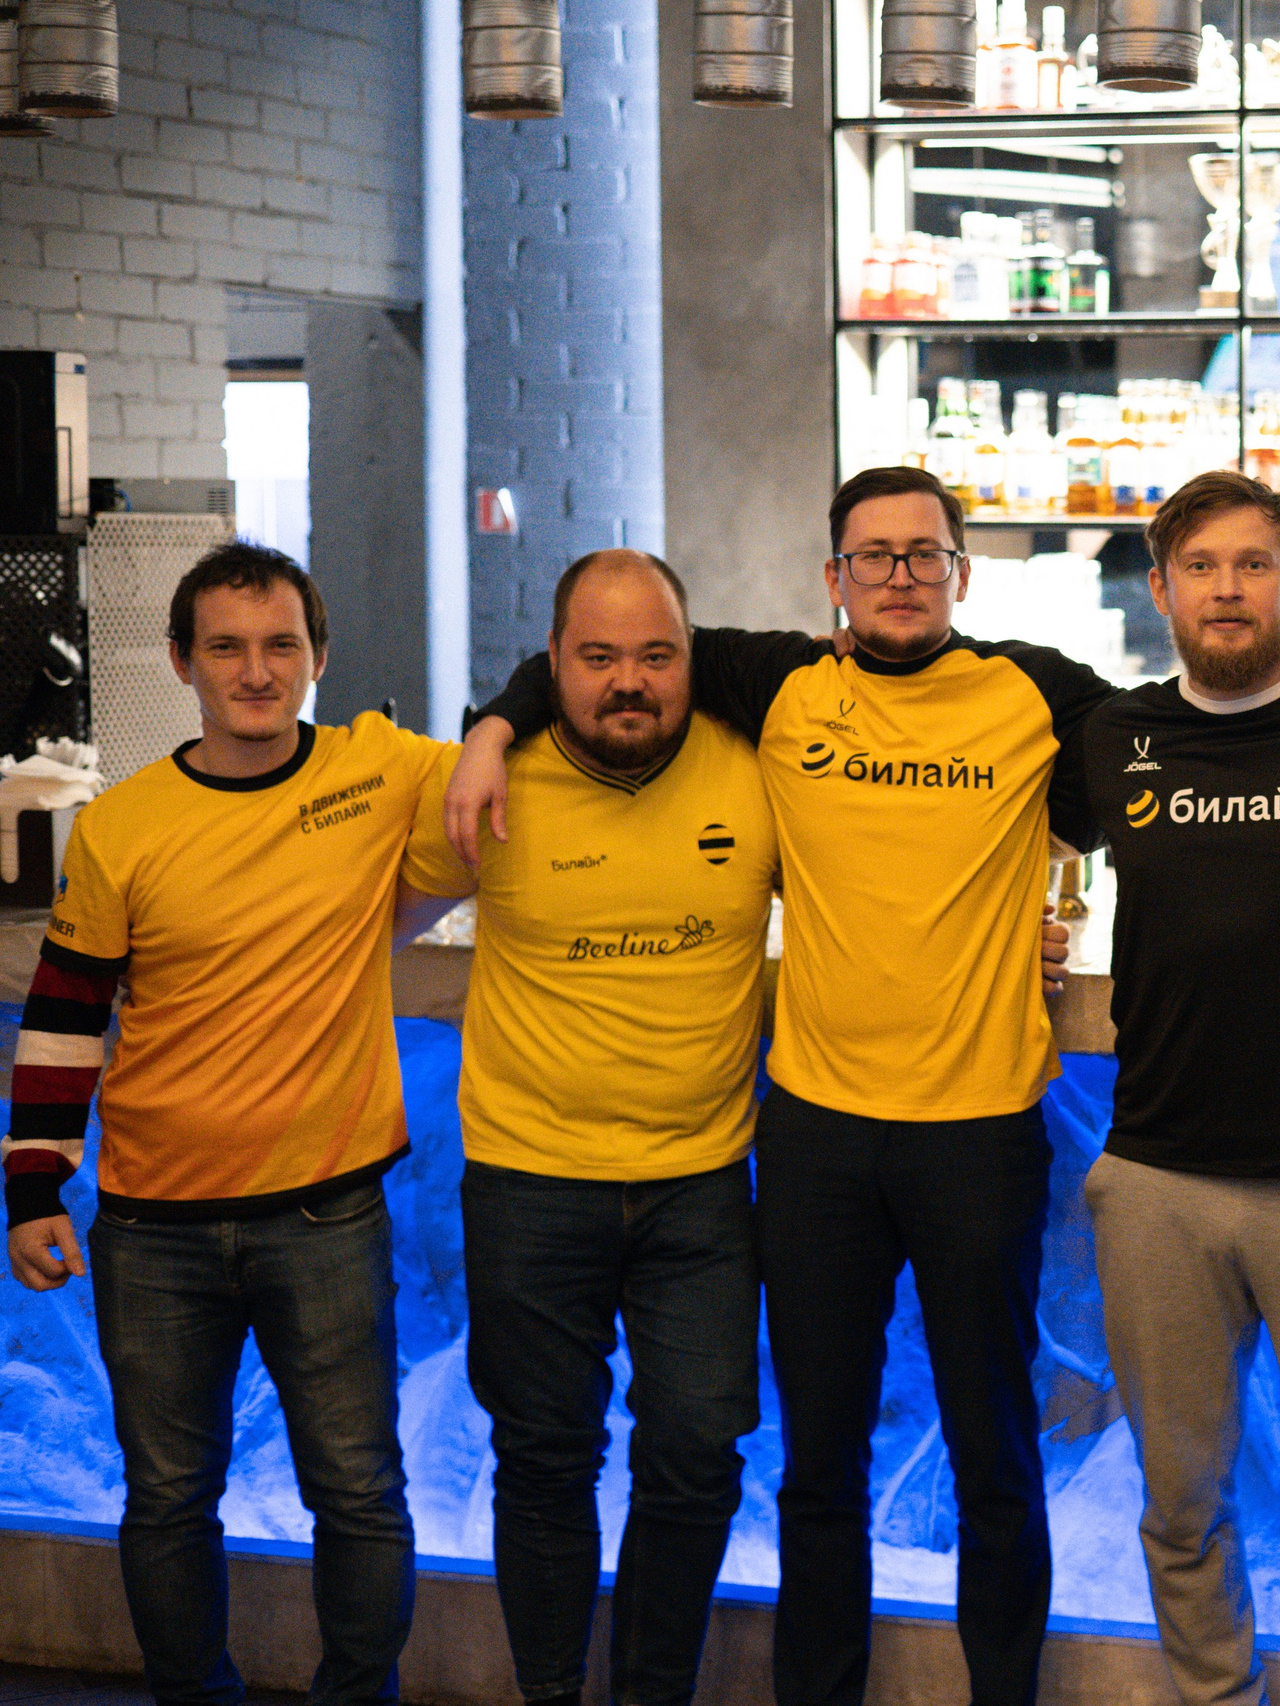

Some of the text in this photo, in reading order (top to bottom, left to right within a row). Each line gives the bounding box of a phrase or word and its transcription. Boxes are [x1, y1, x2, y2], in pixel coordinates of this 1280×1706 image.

[844, 752, 994, 790] билайн
[1124, 761, 1162, 772] JÖGEL
[299, 774, 385, 818] В ДВИЖЕНИИ
[301, 800, 372, 834] С БИЛАЙН
[567, 931, 670, 961] Beeline
